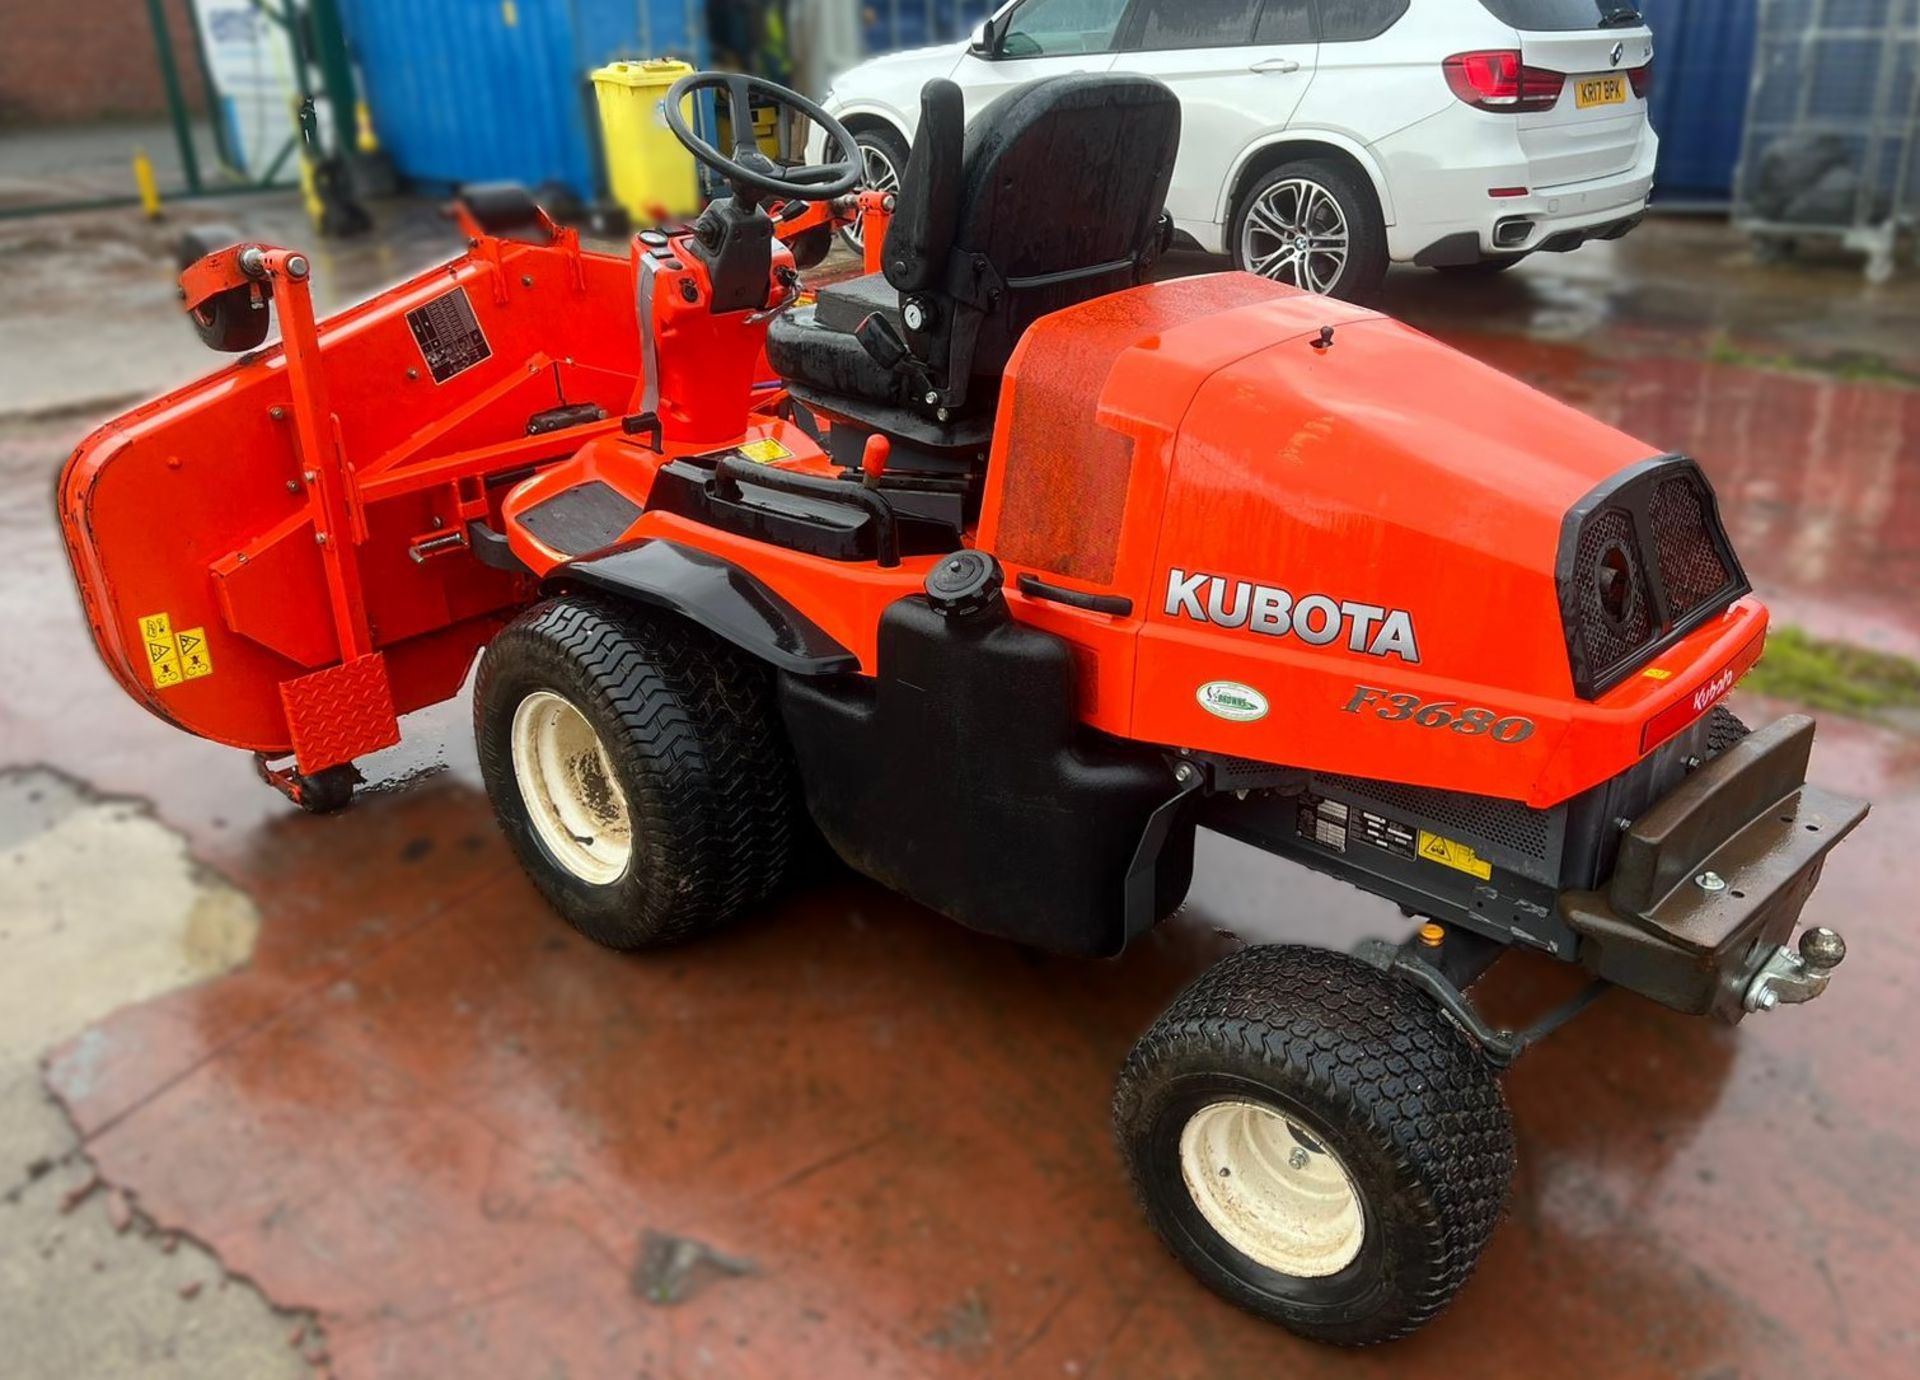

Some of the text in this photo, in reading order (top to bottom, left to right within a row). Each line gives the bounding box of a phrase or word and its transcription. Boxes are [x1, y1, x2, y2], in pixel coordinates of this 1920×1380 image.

[1580, 82, 1602, 103] KR17
[1164, 568, 1420, 663] KUBOTA
[1340, 684, 1536, 744] F3680
